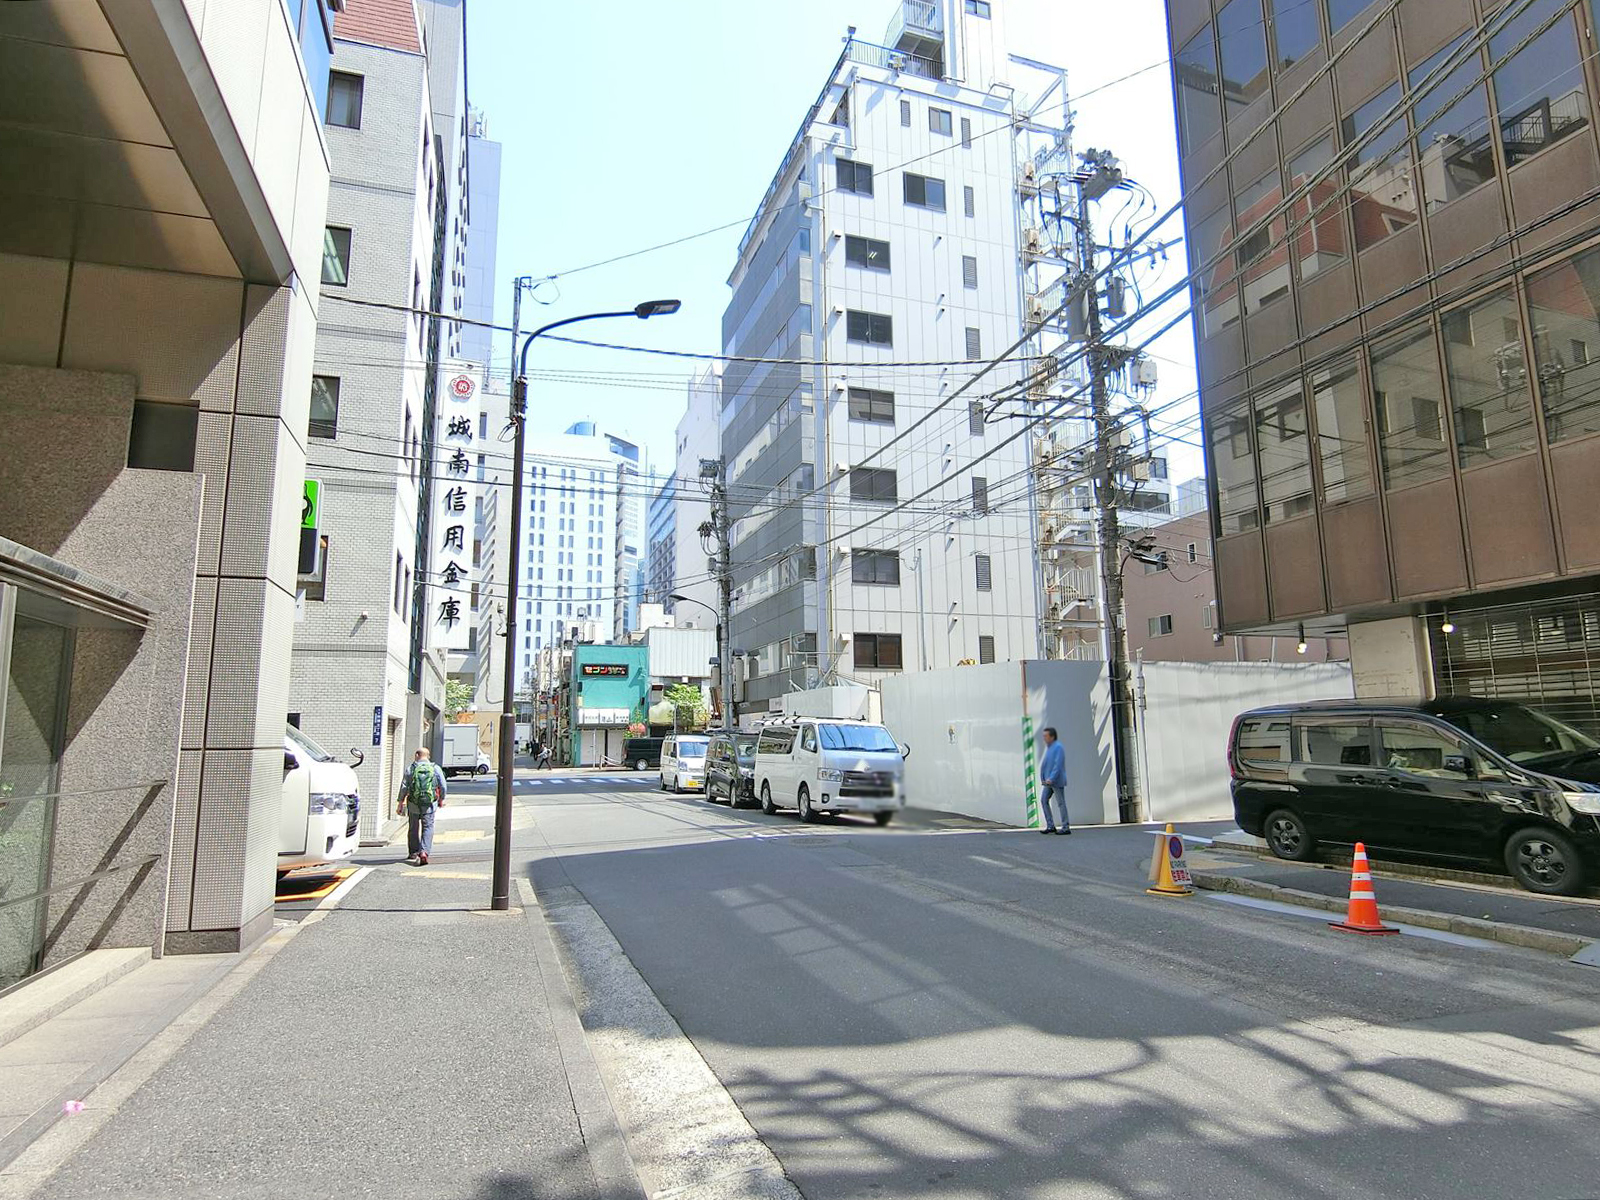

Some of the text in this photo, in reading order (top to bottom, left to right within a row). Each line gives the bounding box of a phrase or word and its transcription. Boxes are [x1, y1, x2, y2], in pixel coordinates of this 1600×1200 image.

[435, 415, 473, 629] 城南信用金庫
